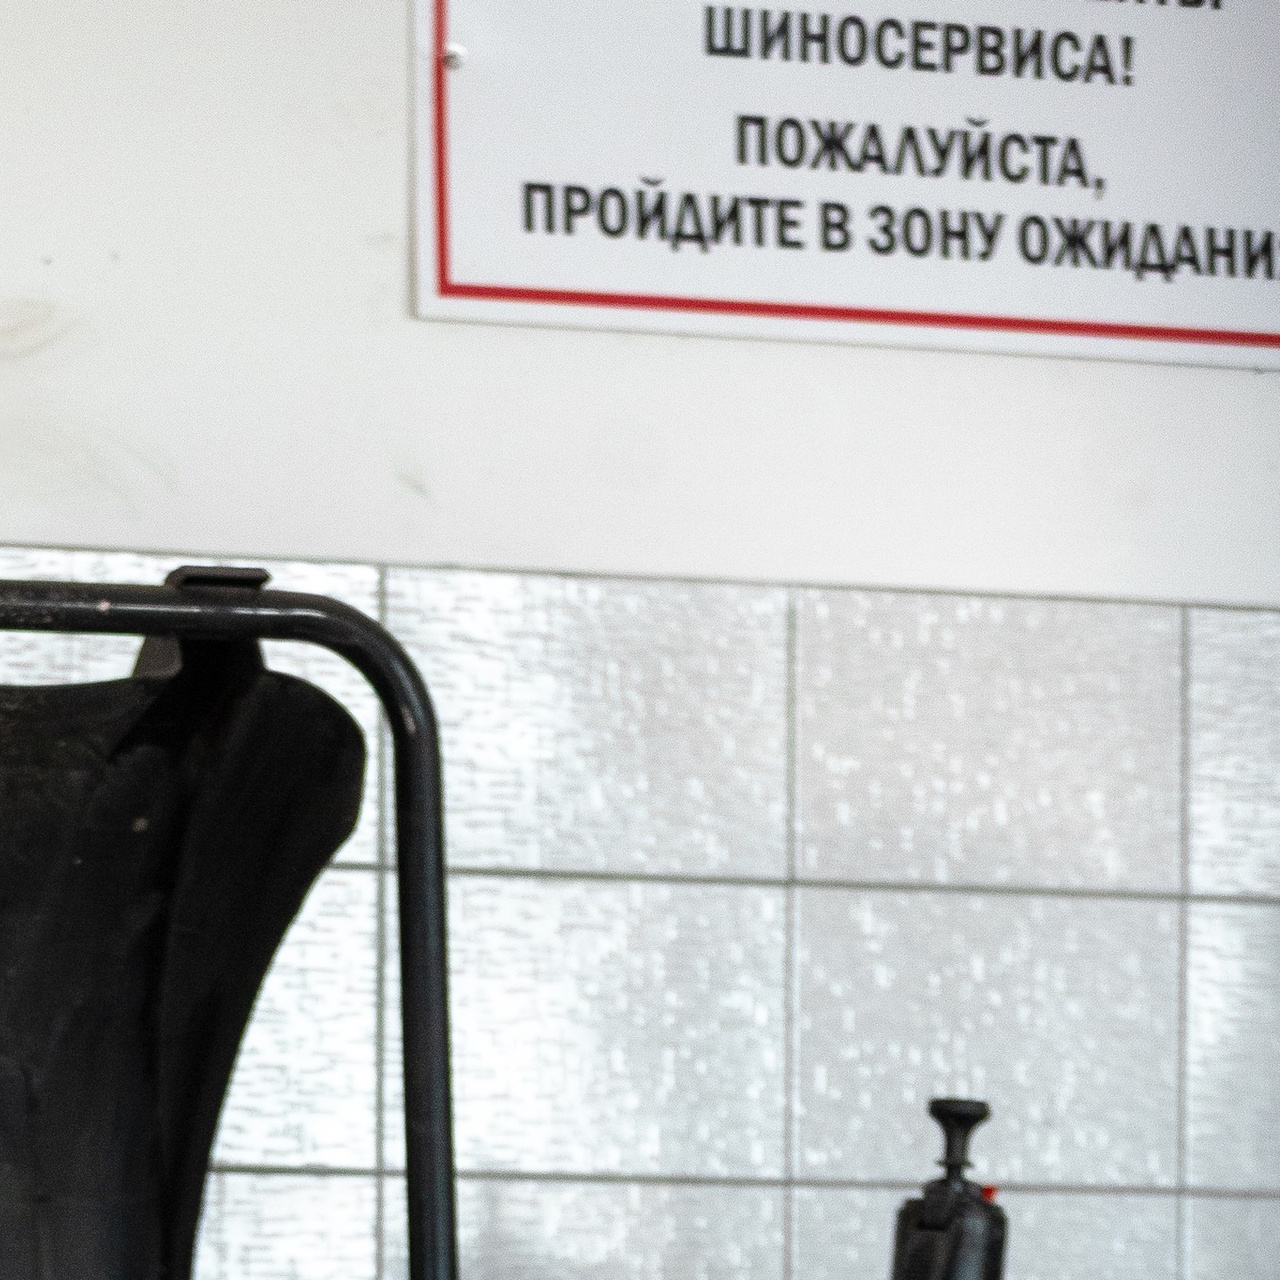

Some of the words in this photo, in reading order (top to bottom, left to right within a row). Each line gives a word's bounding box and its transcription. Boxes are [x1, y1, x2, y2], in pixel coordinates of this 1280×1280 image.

[703, 6, 1136, 87] ШИНОСЕРВИСА!
[735, 114, 1106, 199] ПОЖАЛУЙСТА,
[521, 177, 806, 253] ПРОЙДИТЕ
[819, 201, 852, 253] В
[867, 206, 1005, 264] ЗОНУ
[1017, 212, 1280, 284] ОЖИДАНИ
